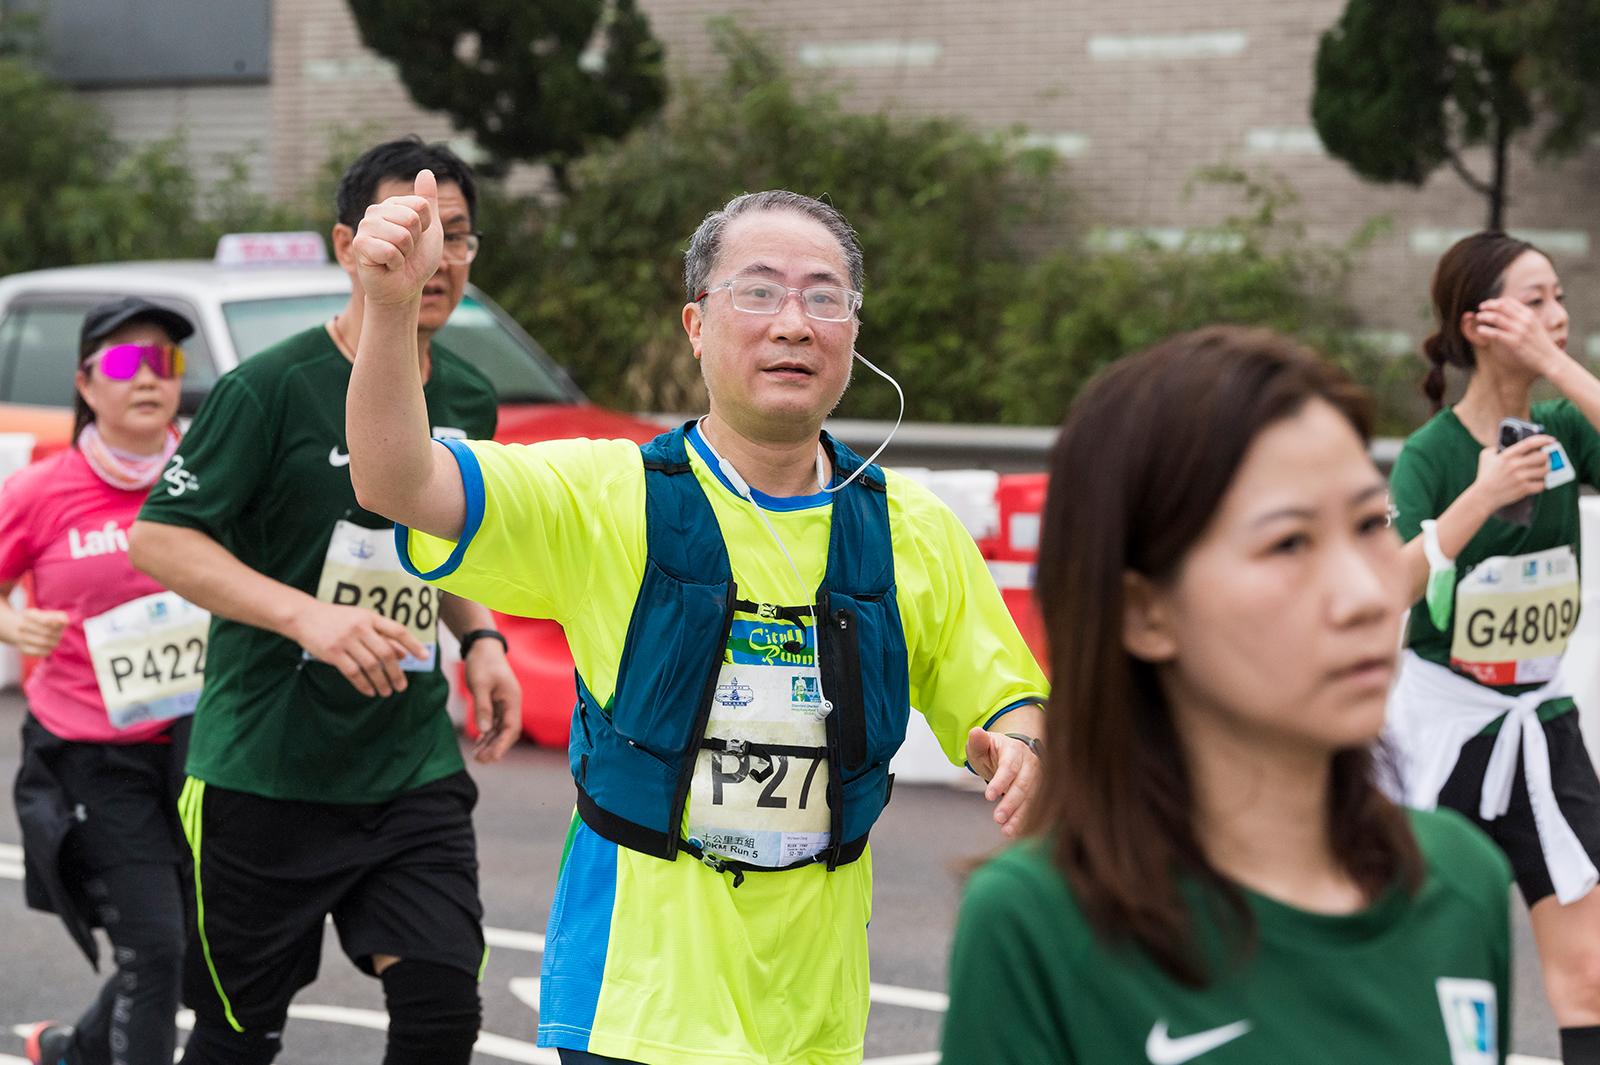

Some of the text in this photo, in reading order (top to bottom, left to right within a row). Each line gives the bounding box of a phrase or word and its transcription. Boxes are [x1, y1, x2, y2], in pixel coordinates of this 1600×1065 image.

[1467, 599, 1573, 647] G4809
[110, 637, 205, 692] P422
[762, 645, 820, 666] Runn
[712, 752, 831, 810] P27
[702, 833, 755, 849] 十公里五組
[730, 845, 749, 856] Run
[752, 850, 759, 859] 5
